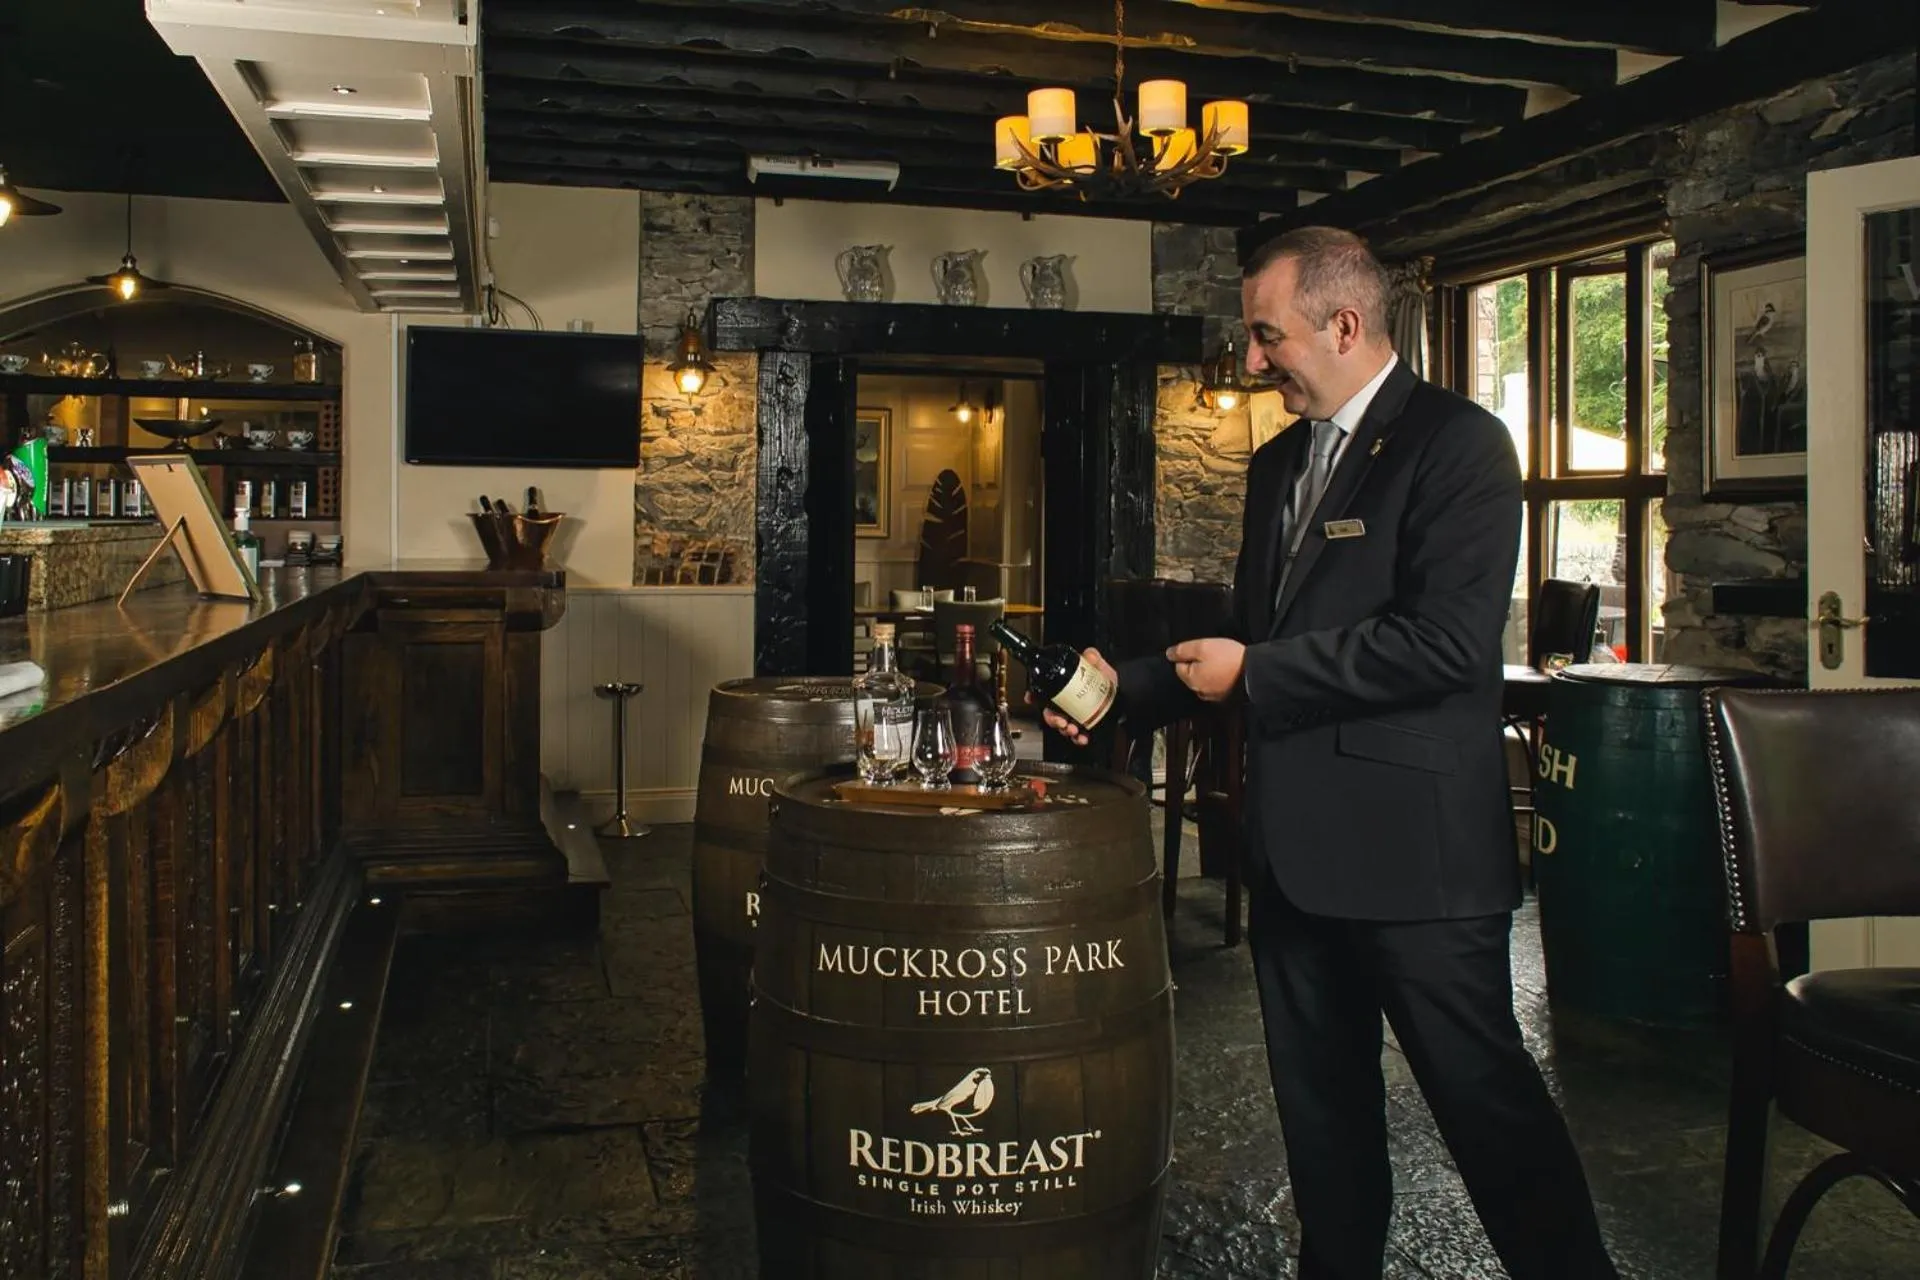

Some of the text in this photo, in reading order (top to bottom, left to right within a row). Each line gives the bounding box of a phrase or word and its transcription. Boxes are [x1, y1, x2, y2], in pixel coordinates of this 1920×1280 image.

[818, 939, 1125, 979] MUCKROSS PARK
[919, 989, 1031, 1016] HOTEL
[850, 1128, 1096, 1178] REDBREAST
[858, 1173, 1077, 1196] SINGLE POT STILL
[910, 1198, 1023, 1216] Irish Whiskey
